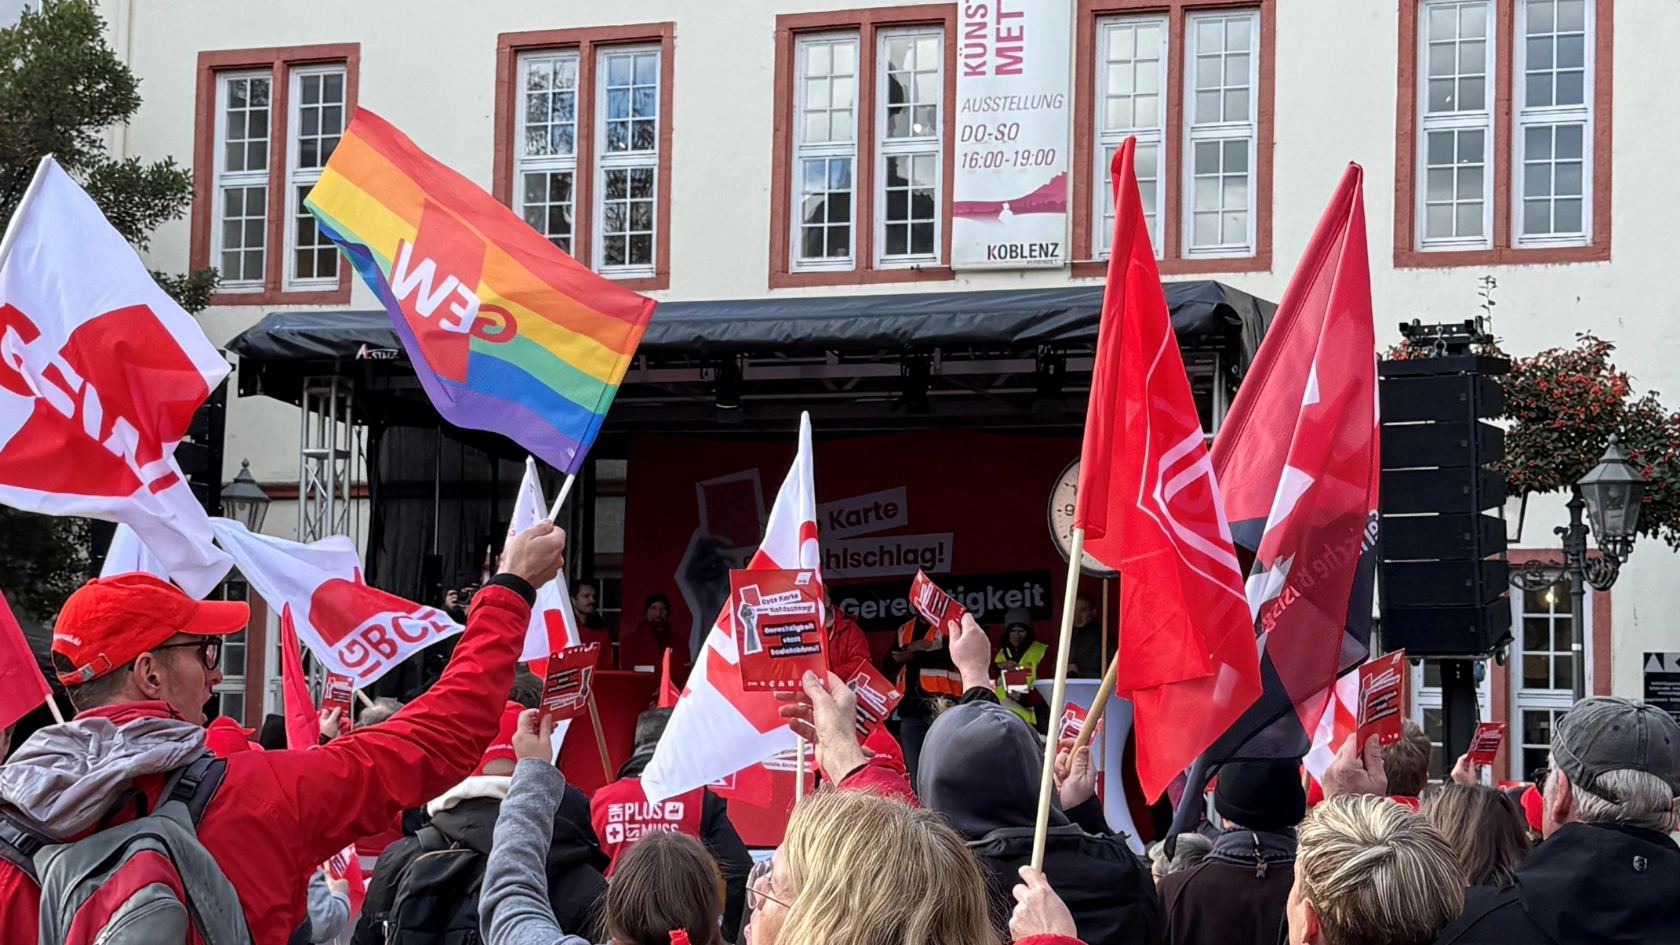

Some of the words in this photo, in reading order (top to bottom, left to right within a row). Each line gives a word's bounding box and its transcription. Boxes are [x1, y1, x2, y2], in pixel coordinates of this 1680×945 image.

[959, 0, 988, 77] KÜNS
[961, 93, 1064, 113] AUSSTELLUNG
[961, 123, 1020, 142] DO-SO
[987, 243, 1059, 260] KOBLENZ
[828, 501, 899, 531] Karte
[820, 541, 945, 571] hlschlag!
[839, 581, 1045, 620] Gereigkeit
[625, 801, 663, 821] PLUS
